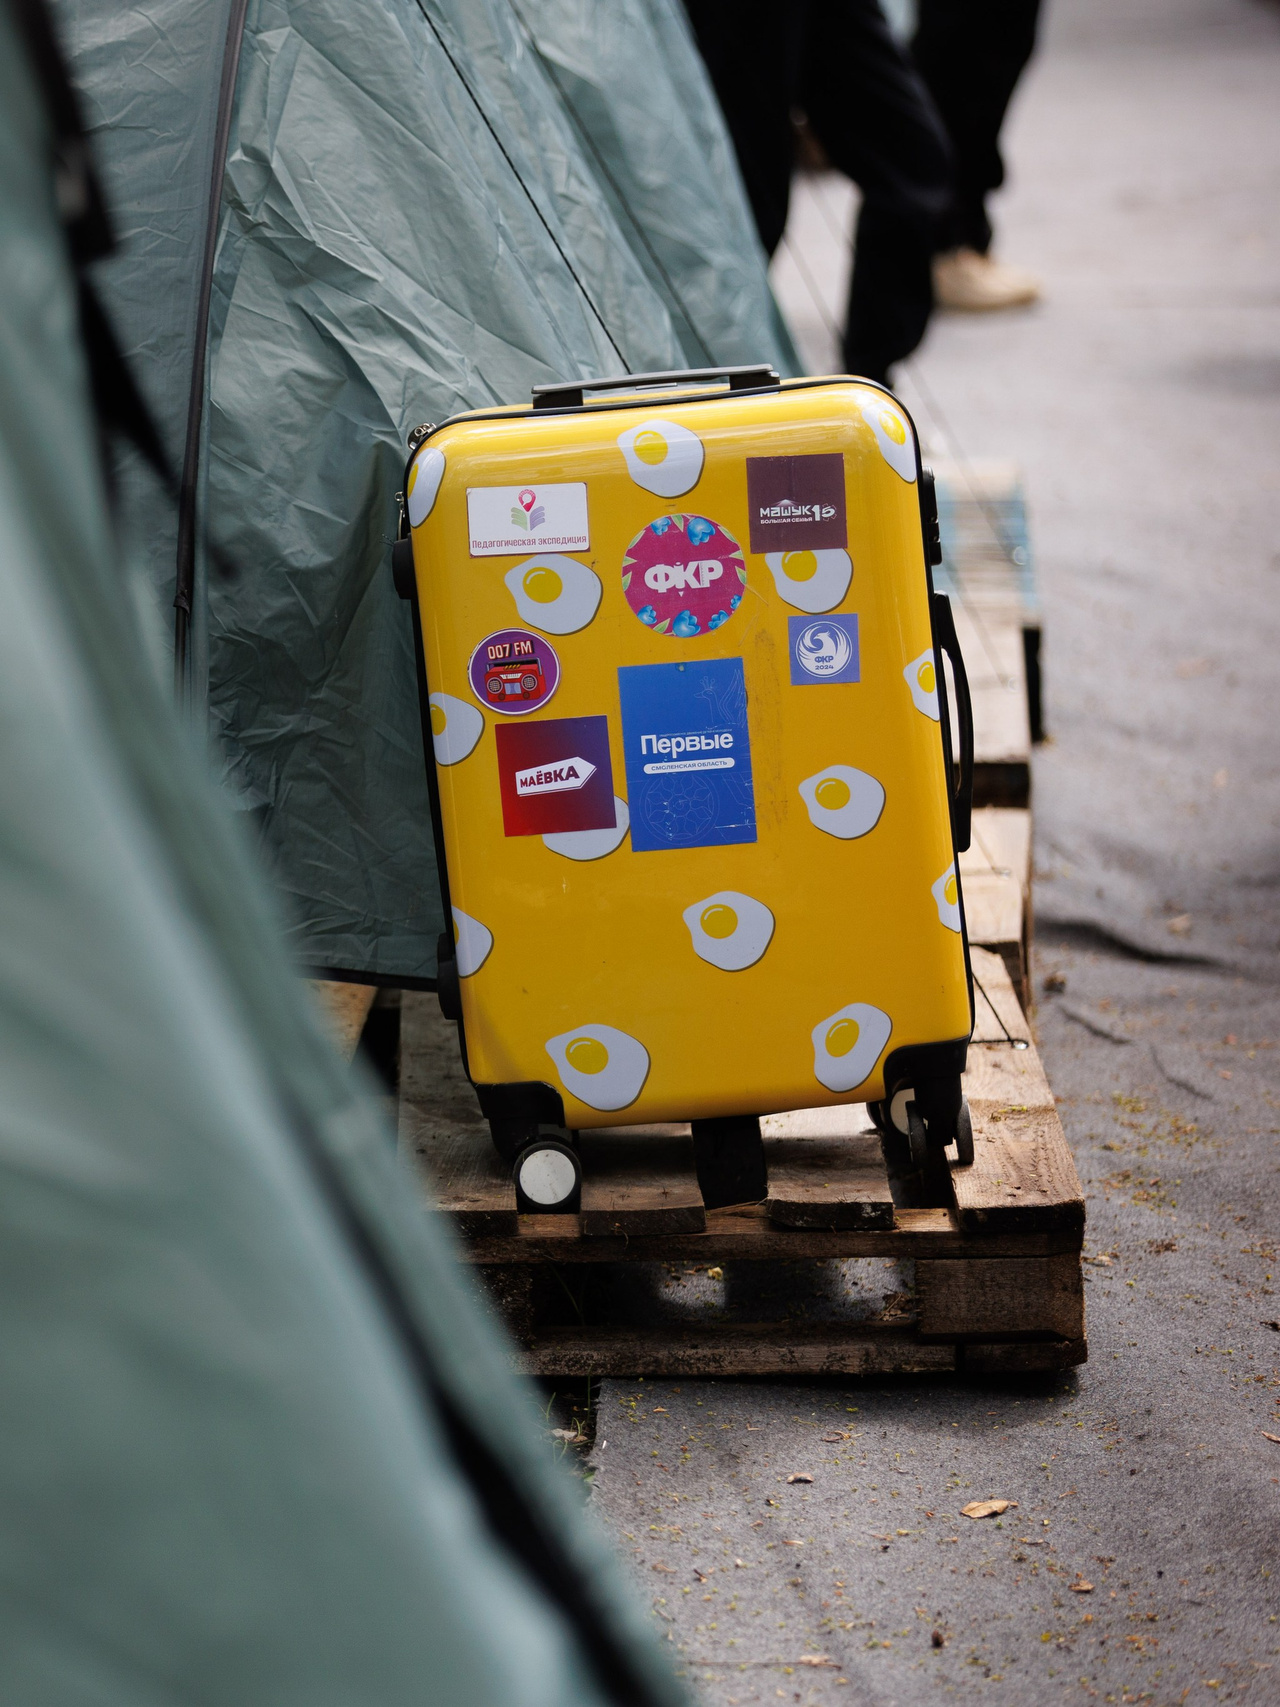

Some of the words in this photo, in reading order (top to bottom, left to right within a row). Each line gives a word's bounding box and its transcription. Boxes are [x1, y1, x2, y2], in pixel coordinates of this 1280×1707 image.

[760, 517, 791, 525] БОЛЬШАЯ
[472, 538, 536, 549] Педагогическая
[538, 535, 587, 546] экспедиция
[644, 559, 724, 594] ФКР
[487, 643, 512, 660] 007
[513, 640, 534, 656] FM
[814, 655, 834, 664] ФКР
[640, 732, 734, 759] Первые
[651, 763, 697, 772] СМОЛЕНСКАЯ
[697, 760, 728, 768] ОБЛАСТЬ
[520, 765, 581, 788] МАЁВКА
